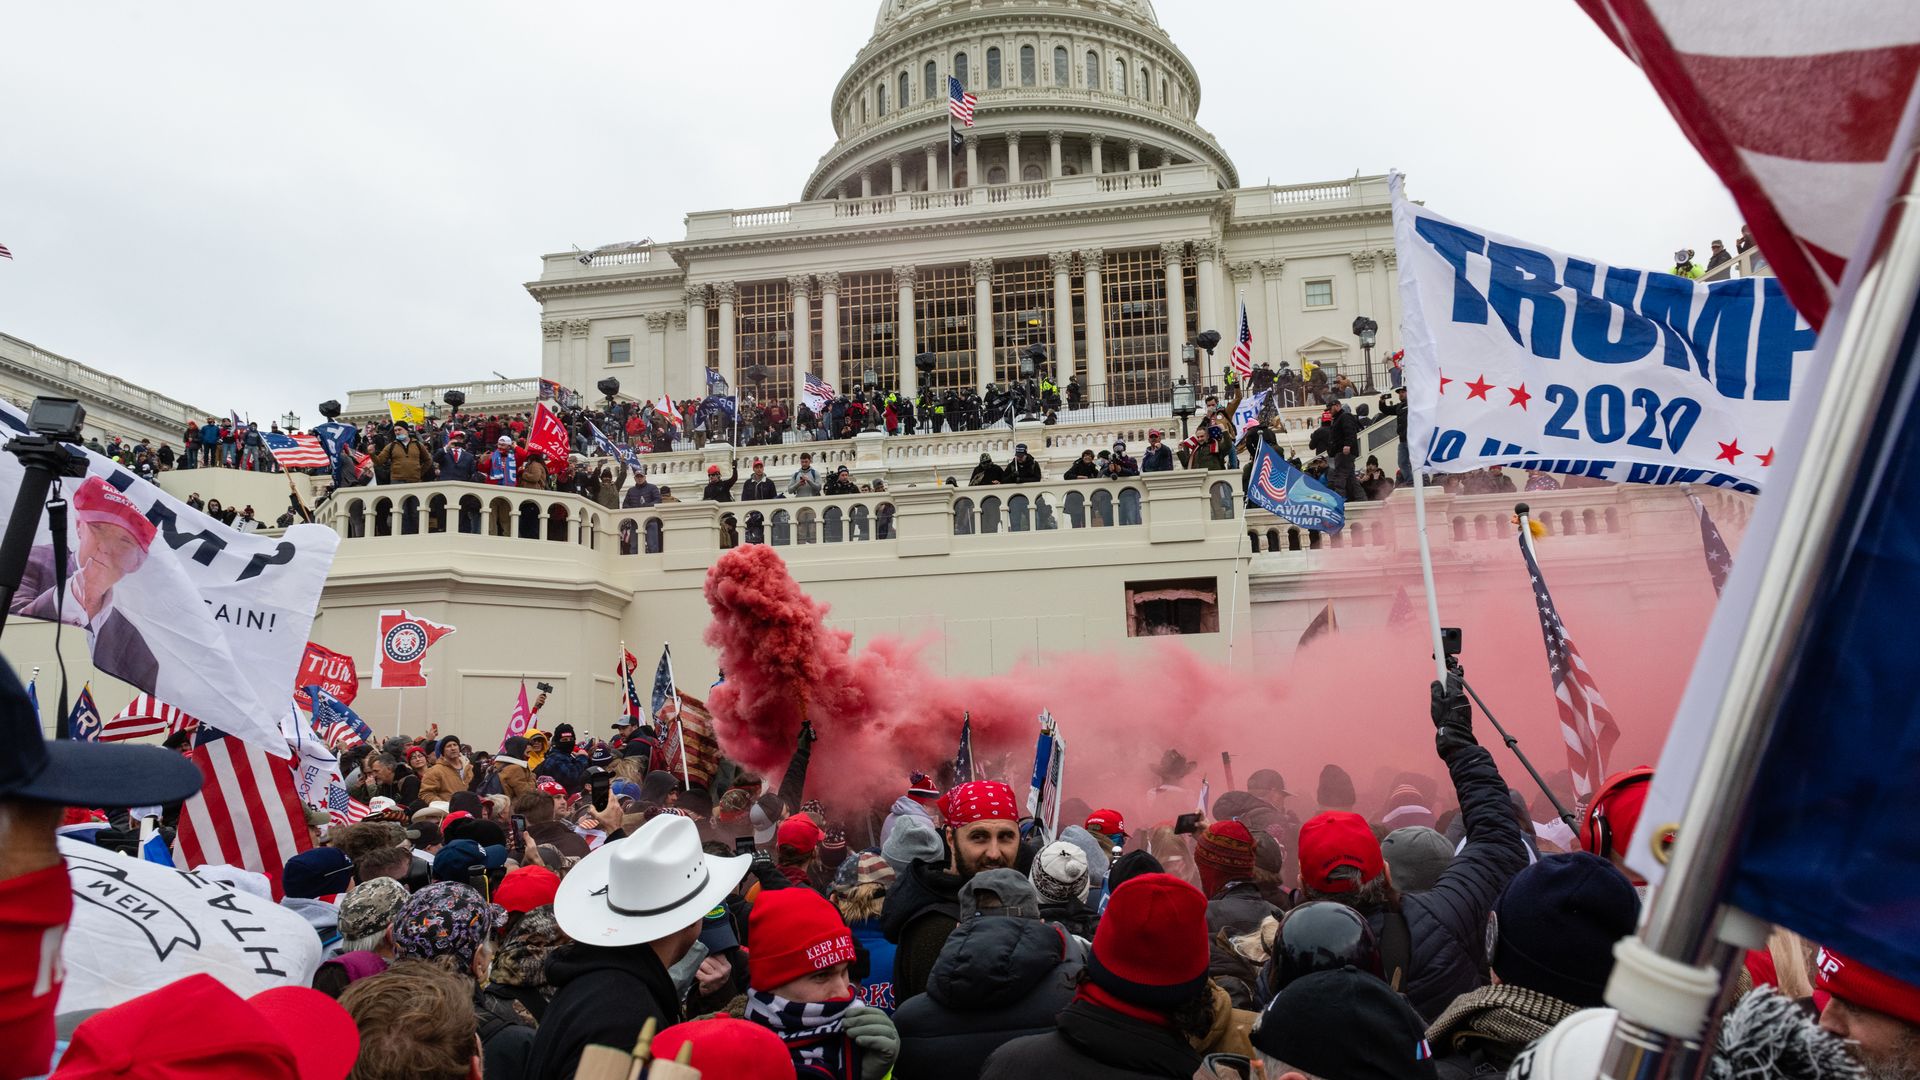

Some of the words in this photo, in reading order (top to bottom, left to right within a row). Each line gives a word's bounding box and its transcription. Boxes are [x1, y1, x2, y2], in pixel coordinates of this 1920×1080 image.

[1544, 384, 1702, 455] 2020
[806, 940, 833, 960] KEEP
[814, 949, 846, 969] GREAT
